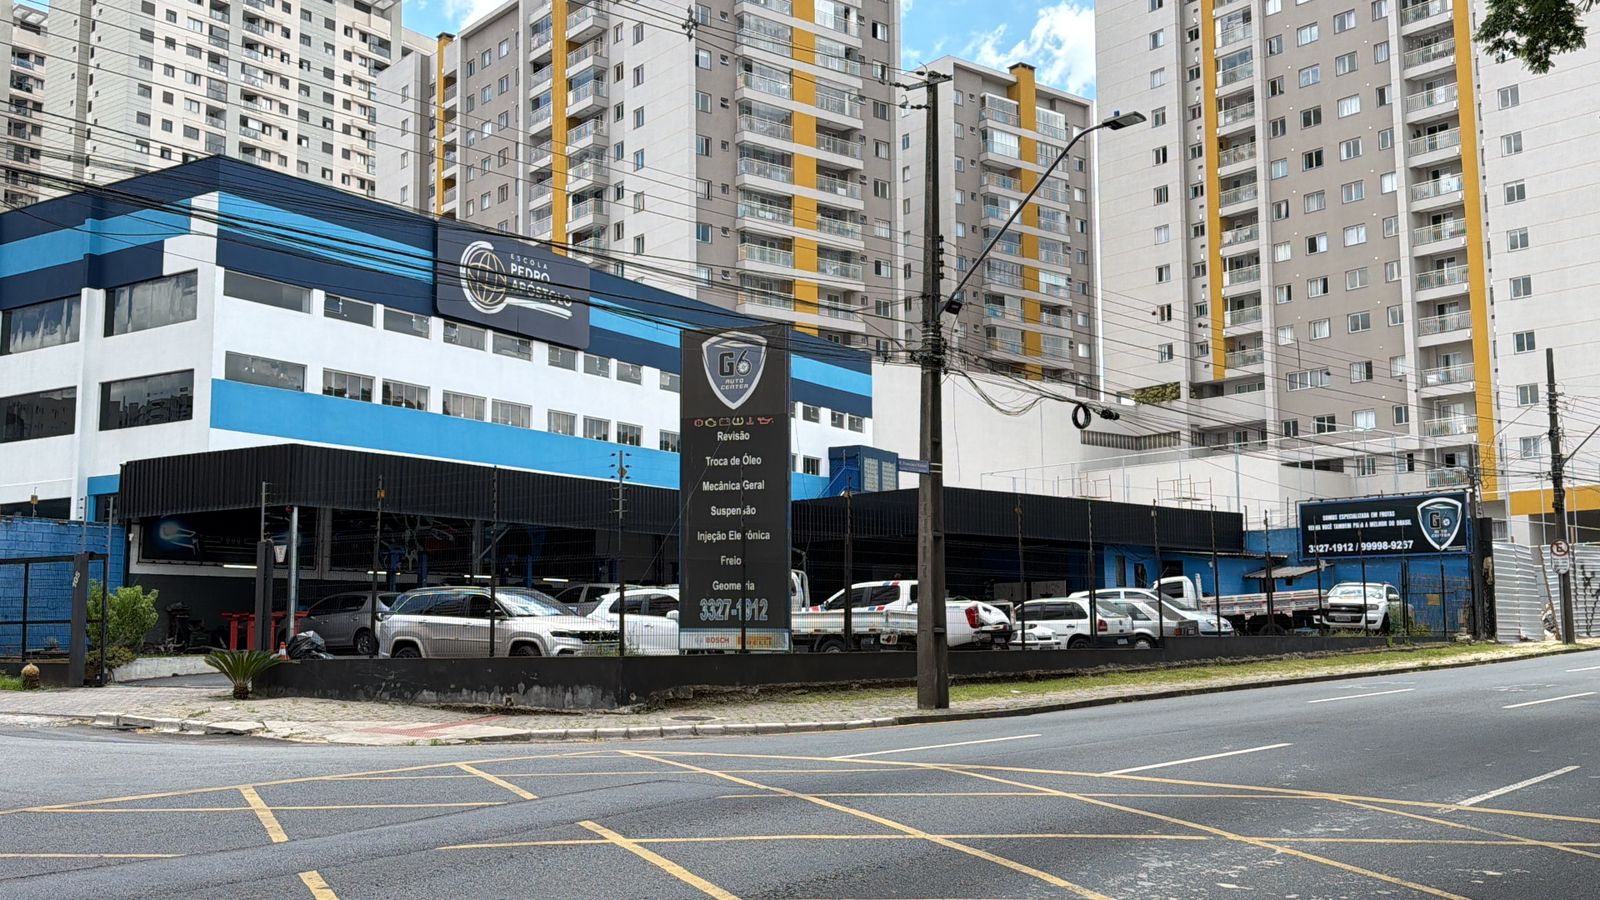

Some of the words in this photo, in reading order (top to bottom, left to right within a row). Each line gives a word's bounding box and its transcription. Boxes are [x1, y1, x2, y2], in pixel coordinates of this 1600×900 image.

[511, 254, 547, 269] ESCOLA
[511, 262, 550, 284] PEDRO
[512, 280, 572, 307] APÓSTOLO
[718, 349, 752, 377] G6
[717, 431, 750, 441] Revisão
[705, 456, 728, 466] Troca
[730, 456, 740, 465] de
[742, 453, 762, 465] Óleo
[702, 481, 740, 491] Mecânica
[742, 480, 765, 490] Geral
[697, 531, 726, 543] Injeção
[720, 556, 742, 565] Freio
[712, 580, 755, 591] Geomeia
[705, 636, 730, 644] BOSCH
